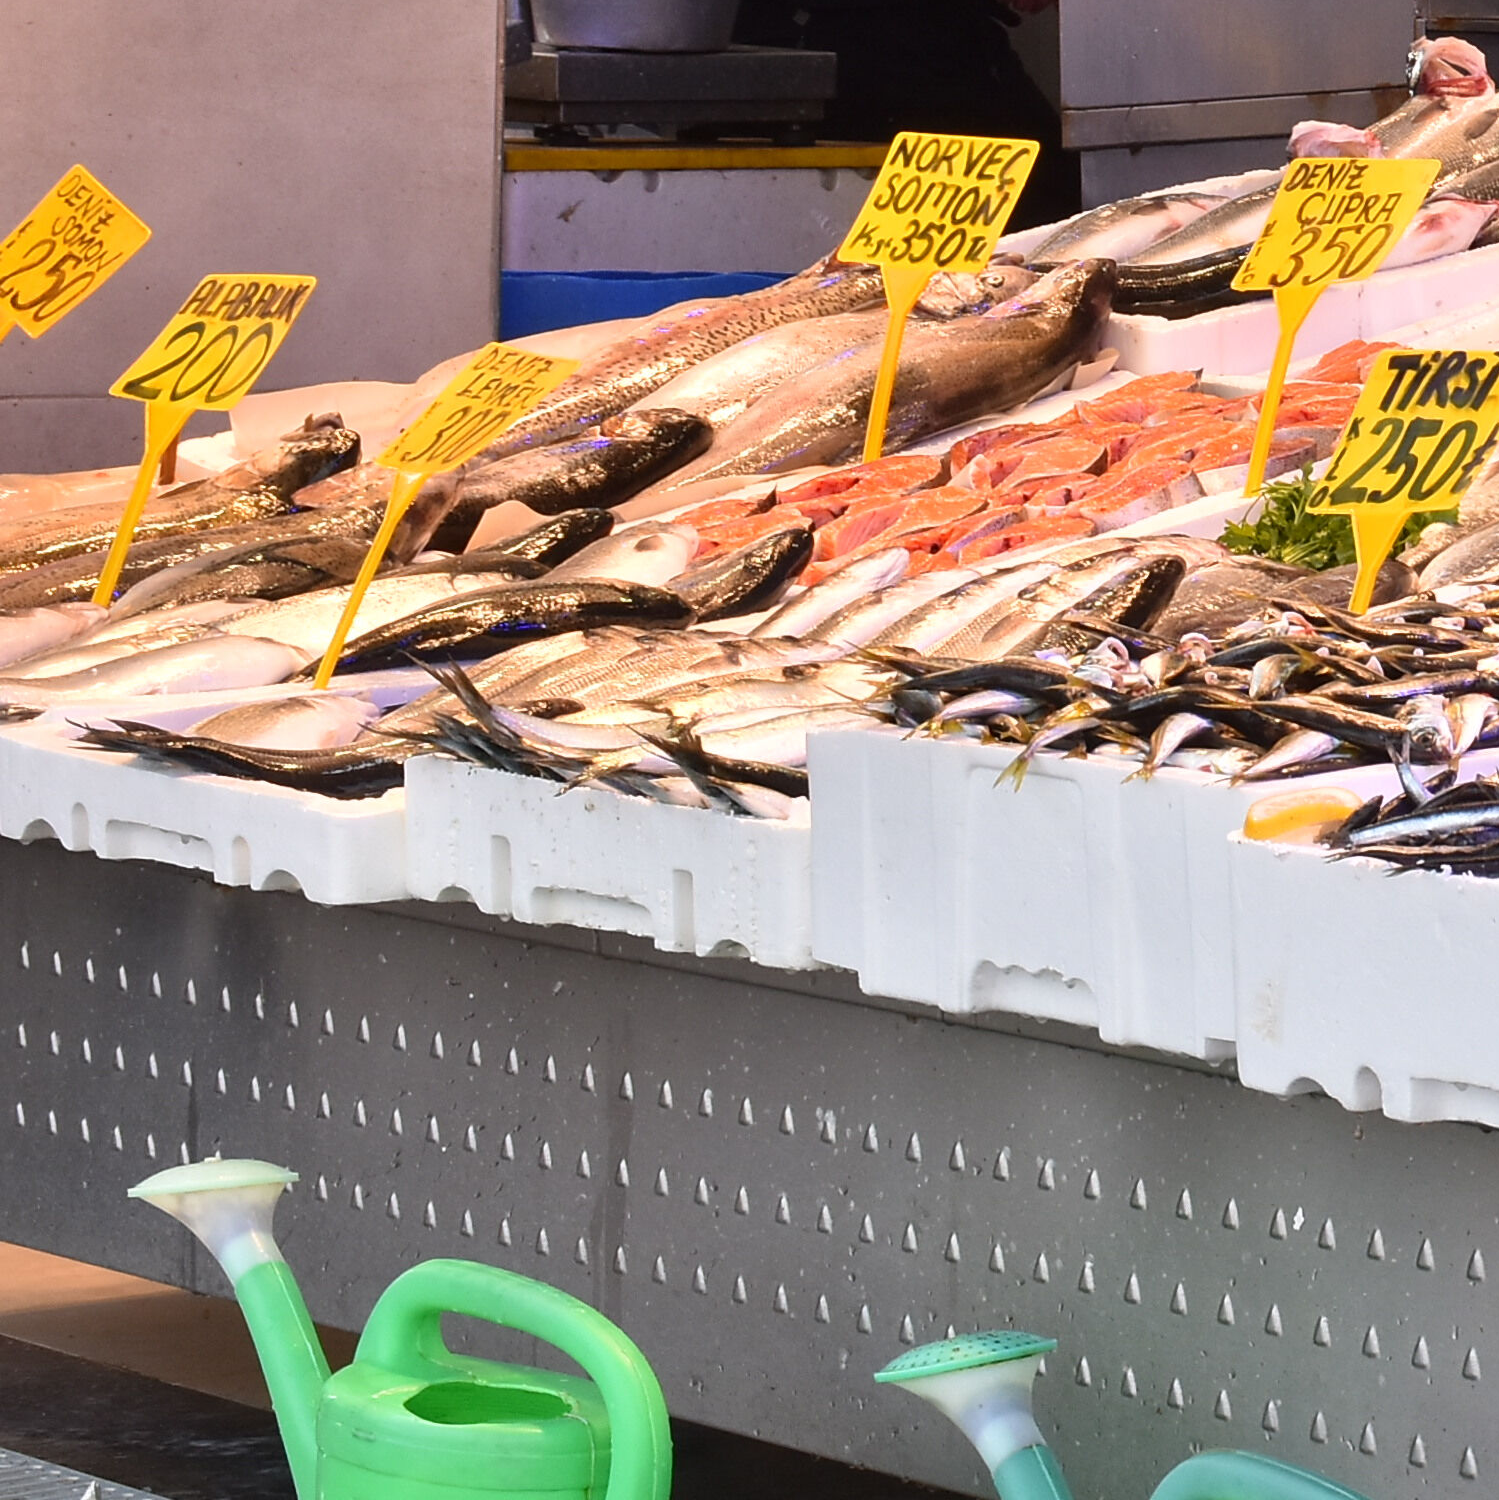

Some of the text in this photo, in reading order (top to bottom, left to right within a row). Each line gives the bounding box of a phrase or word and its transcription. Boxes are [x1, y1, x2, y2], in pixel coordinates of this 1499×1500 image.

[889, 135, 1031, 193] NORVEÇ
[873, 172, 1010, 227] SOMON
[51, 215, 124, 273] SOMON
[1268, 223, 1394, 288] 350
[0, 238, 96, 323] 250
[122, 320, 274, 404] 200
[400, 404, 513, 465] 300
